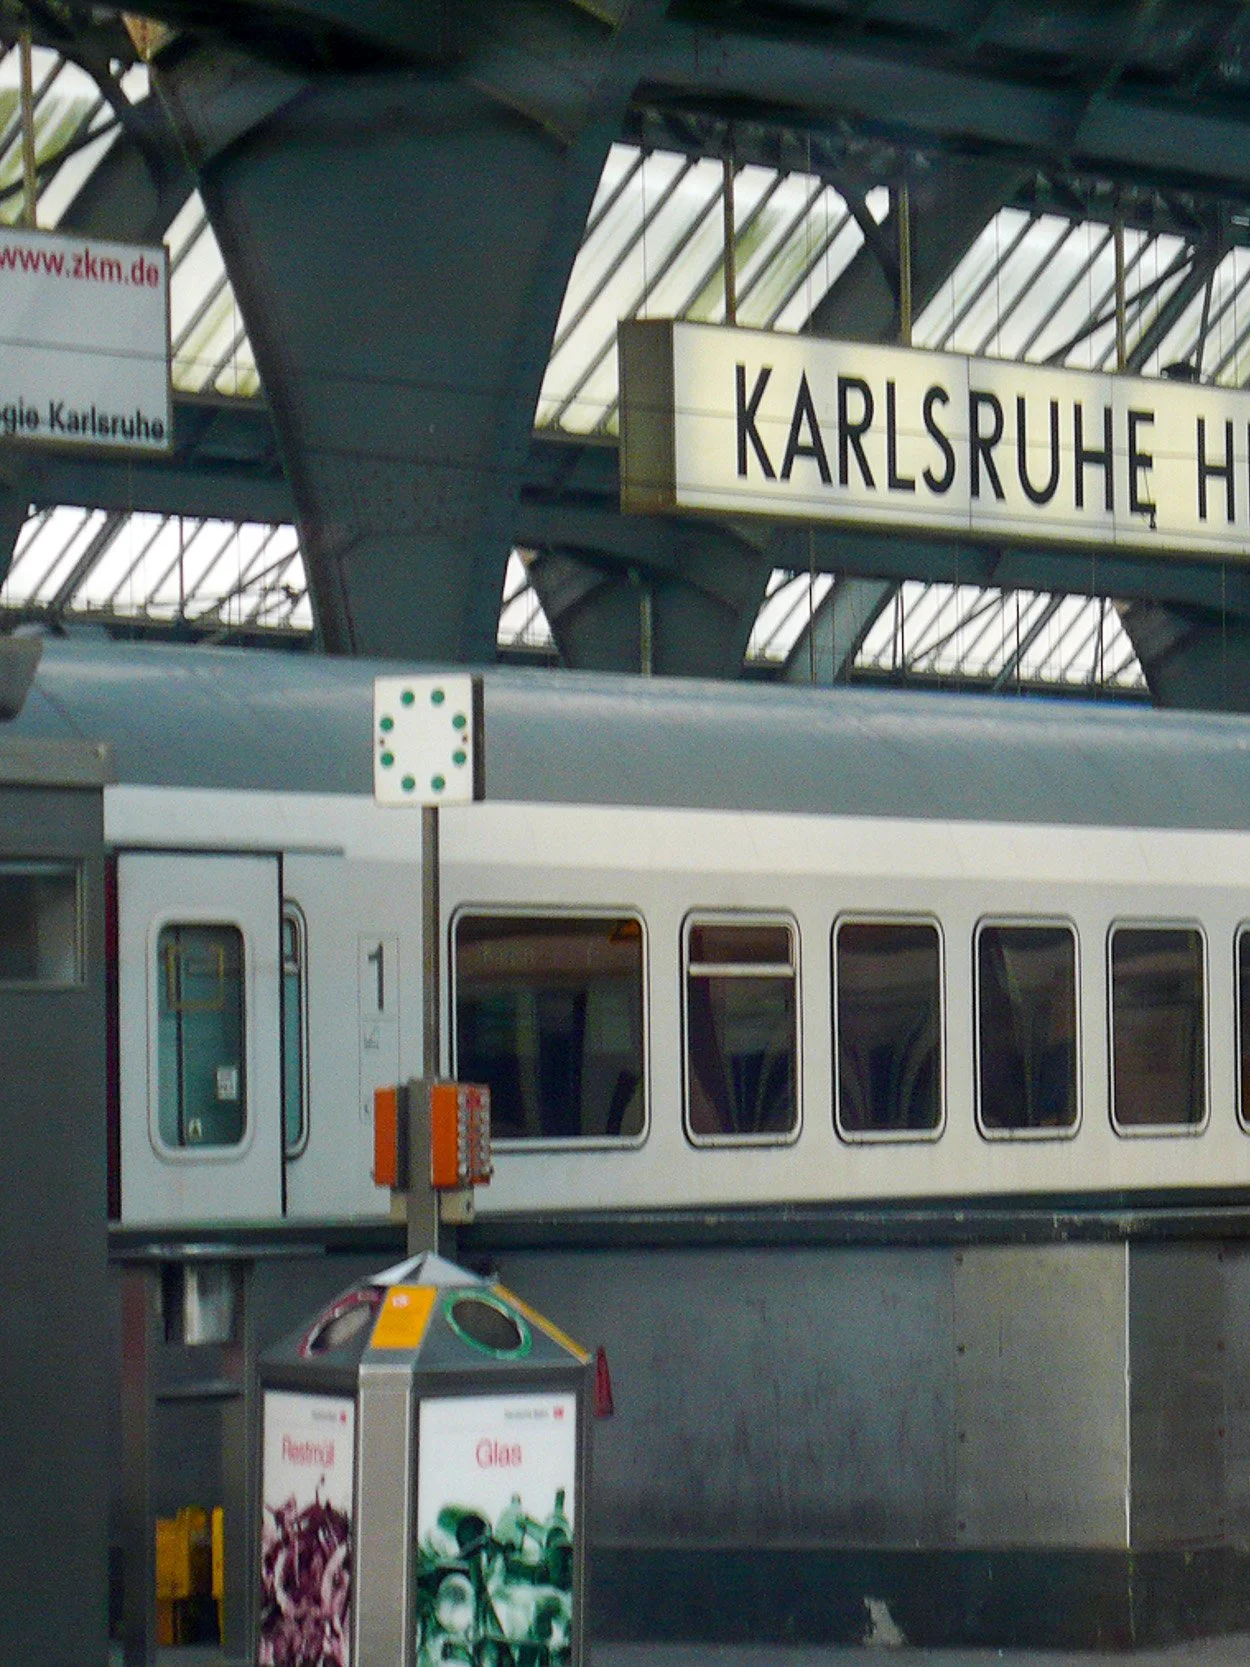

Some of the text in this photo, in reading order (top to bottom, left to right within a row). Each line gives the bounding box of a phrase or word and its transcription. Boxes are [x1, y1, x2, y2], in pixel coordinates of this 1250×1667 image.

[50, 399, 164, 440] Karlsruhe
[735, 363, 1155, 517] KARLSRUHE
[476, 1437, 523, 1469] Glas
